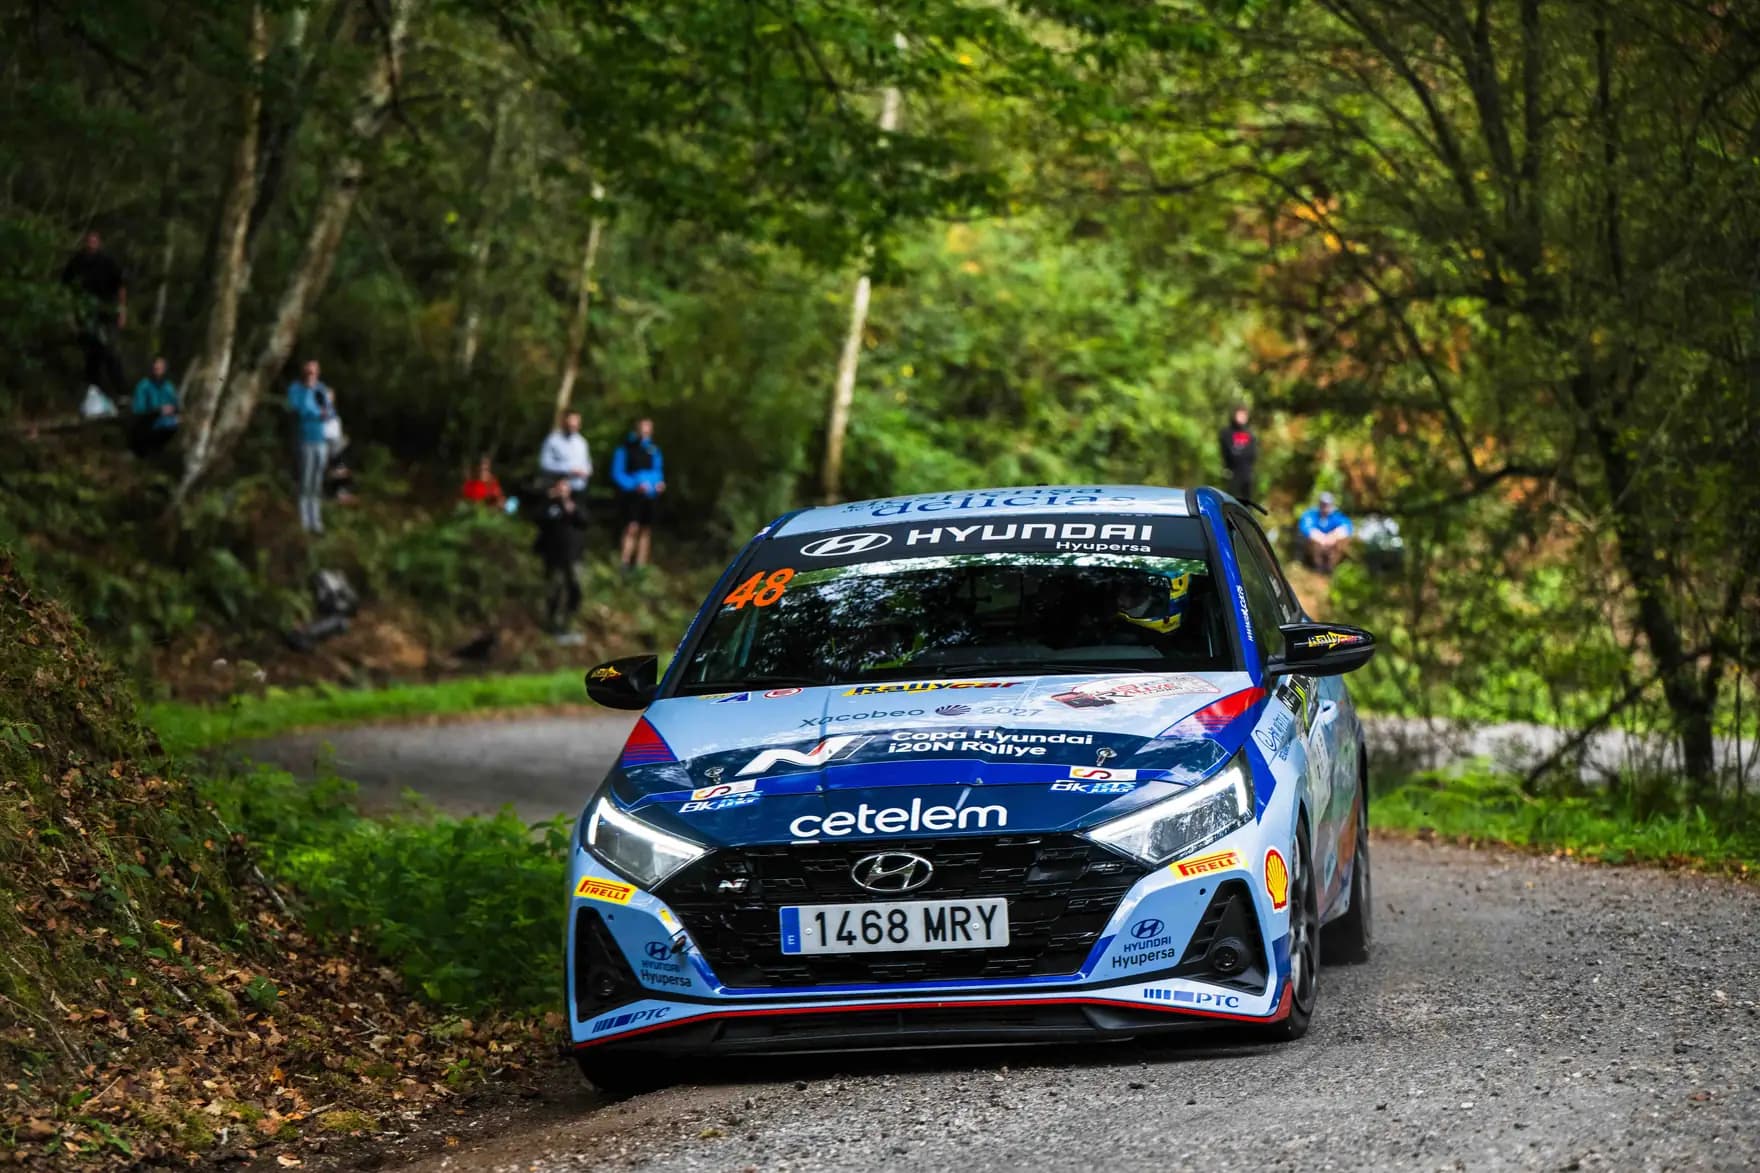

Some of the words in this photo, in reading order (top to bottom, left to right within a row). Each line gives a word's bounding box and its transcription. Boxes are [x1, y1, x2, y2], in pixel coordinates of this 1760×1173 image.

[906, 523, 1153, 546] HYUNDAI
[1056, 541, 1151, 553] Hyupersa
[723, 568, 795, 610] 48
[800, 709, 925, 728] xacobeo
[981, 705, 1043, 717] 2027
[892, 731, 967, 742] Copa
[973, 730, 1093, 745] Hyundai
[888, 742, 955, 753] i20N
[961, 741, 1047, 756] Rallye
[789, 798, 1007, 838] cetelem
[1178, 852, 1240, 876] PIRELLI
[579, 880, 630, 901] PIRELLI
[815, 908, 909, 947] 1468
[923, 904, 998, 943] MRY
[788, 935, 795, 945] E
[1123, 936, 1172, 953] HYUNDAI
[1112, 948, 1175, 969] Hyupersa
[640, 970, 692, 988] Hyupersa
[1196, 992, 1239, 1008] PTC
[631, 1007, 671, 1023] PTC
